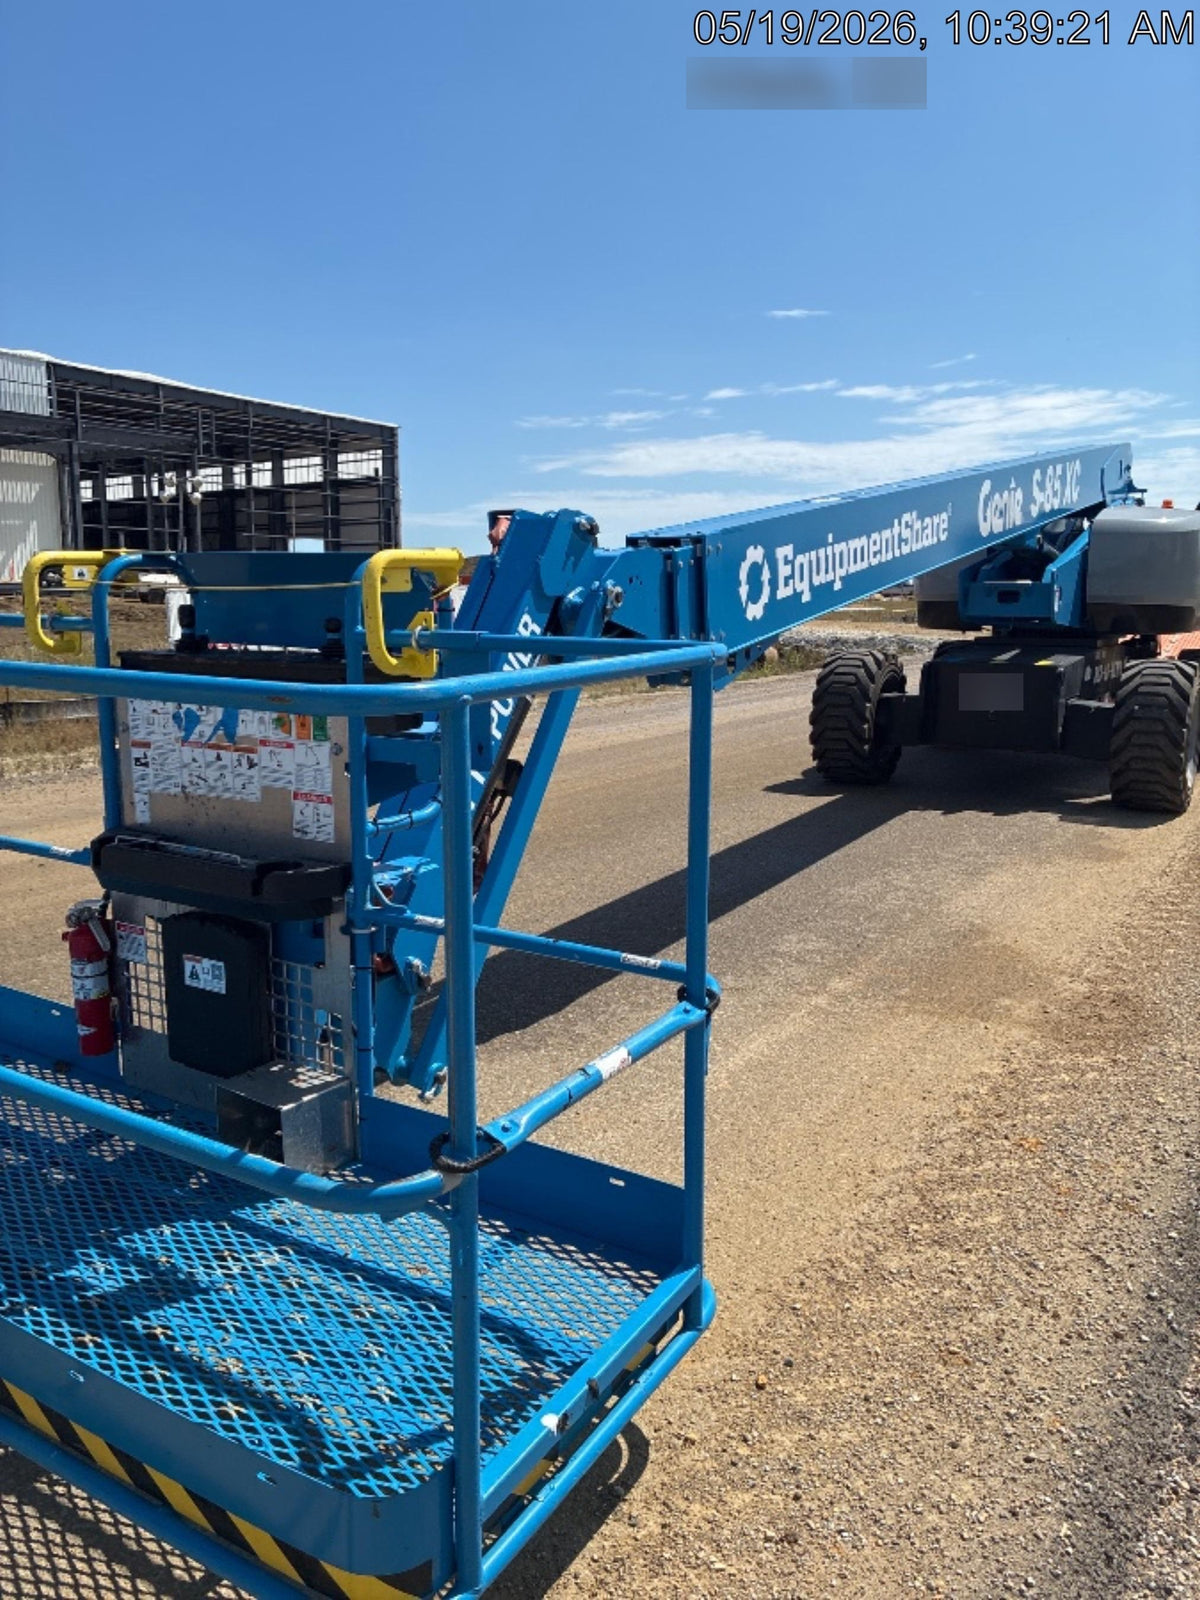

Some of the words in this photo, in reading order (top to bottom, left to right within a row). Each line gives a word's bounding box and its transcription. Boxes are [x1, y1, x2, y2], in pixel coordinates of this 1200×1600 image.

[978, 477, 1023, 537] Genie
[1031, 463, 1063, 518] S-85
[1063, 459, 1081, 504] XC
[776, 510, 948, 604] EquipmentShare
